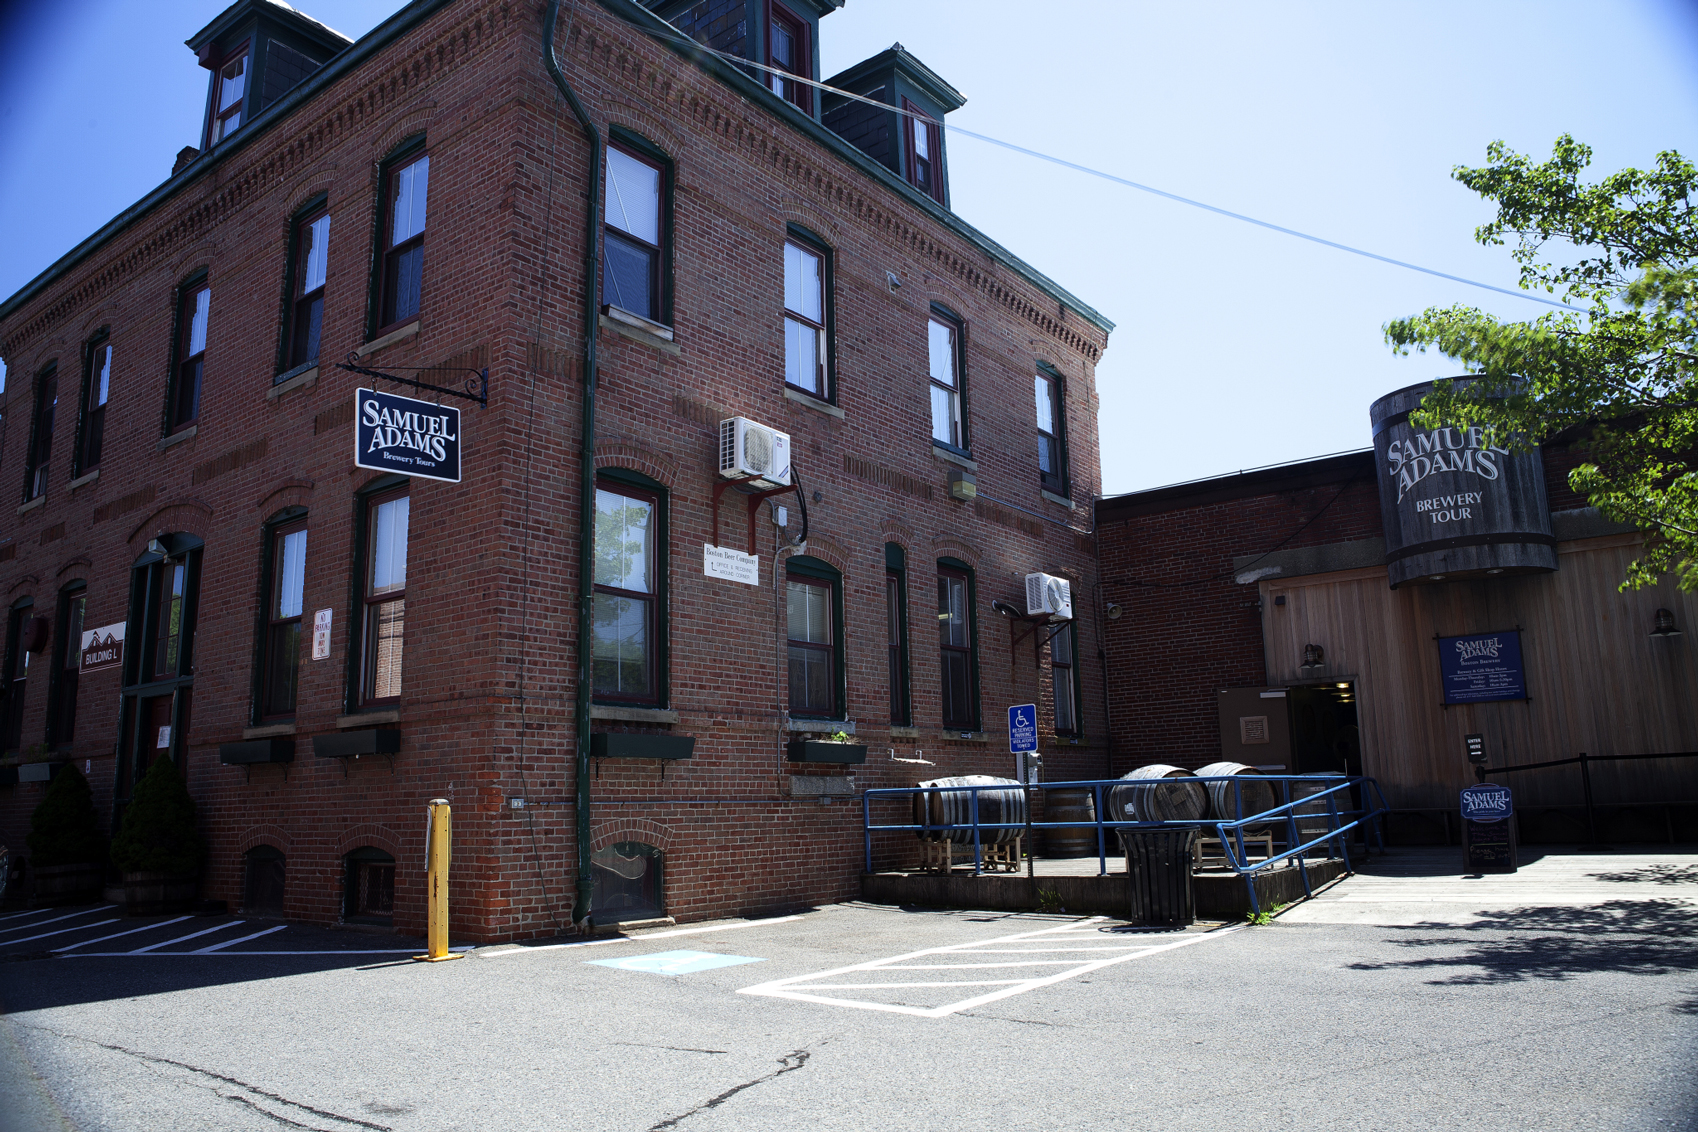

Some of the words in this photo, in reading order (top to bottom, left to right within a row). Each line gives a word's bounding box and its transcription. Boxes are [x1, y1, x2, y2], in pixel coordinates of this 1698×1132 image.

[362, 399, 456, 442] SAMUEL
[367, 426, 447, 462] ADAMS
[1388, 424, 1510, 476] SAMUEL
[383, 451, 414, 465] Brewery
[415, 456, 436, 468] Tours
[1397, 450, 1499, 504] ADAMS
[1416, 491, 1483, 513] BREWERY
[1430, 507, 1472, 524] TOUR
[706, 547, 723, 558] Boston
[725, 551, 735, 560] Beer
[736, 554, 756, 566] Company
[1455, 637, 1502, 652] SAMUEL
[85, 648, 112, 665] BUILDING
[113, 648, 117, 659] L
[1460, 647, 1498, 662] ADAMS
[1463, 790, 1509, 804] SAMUEL
[1467, 801, 1506, 813] ADAMS
